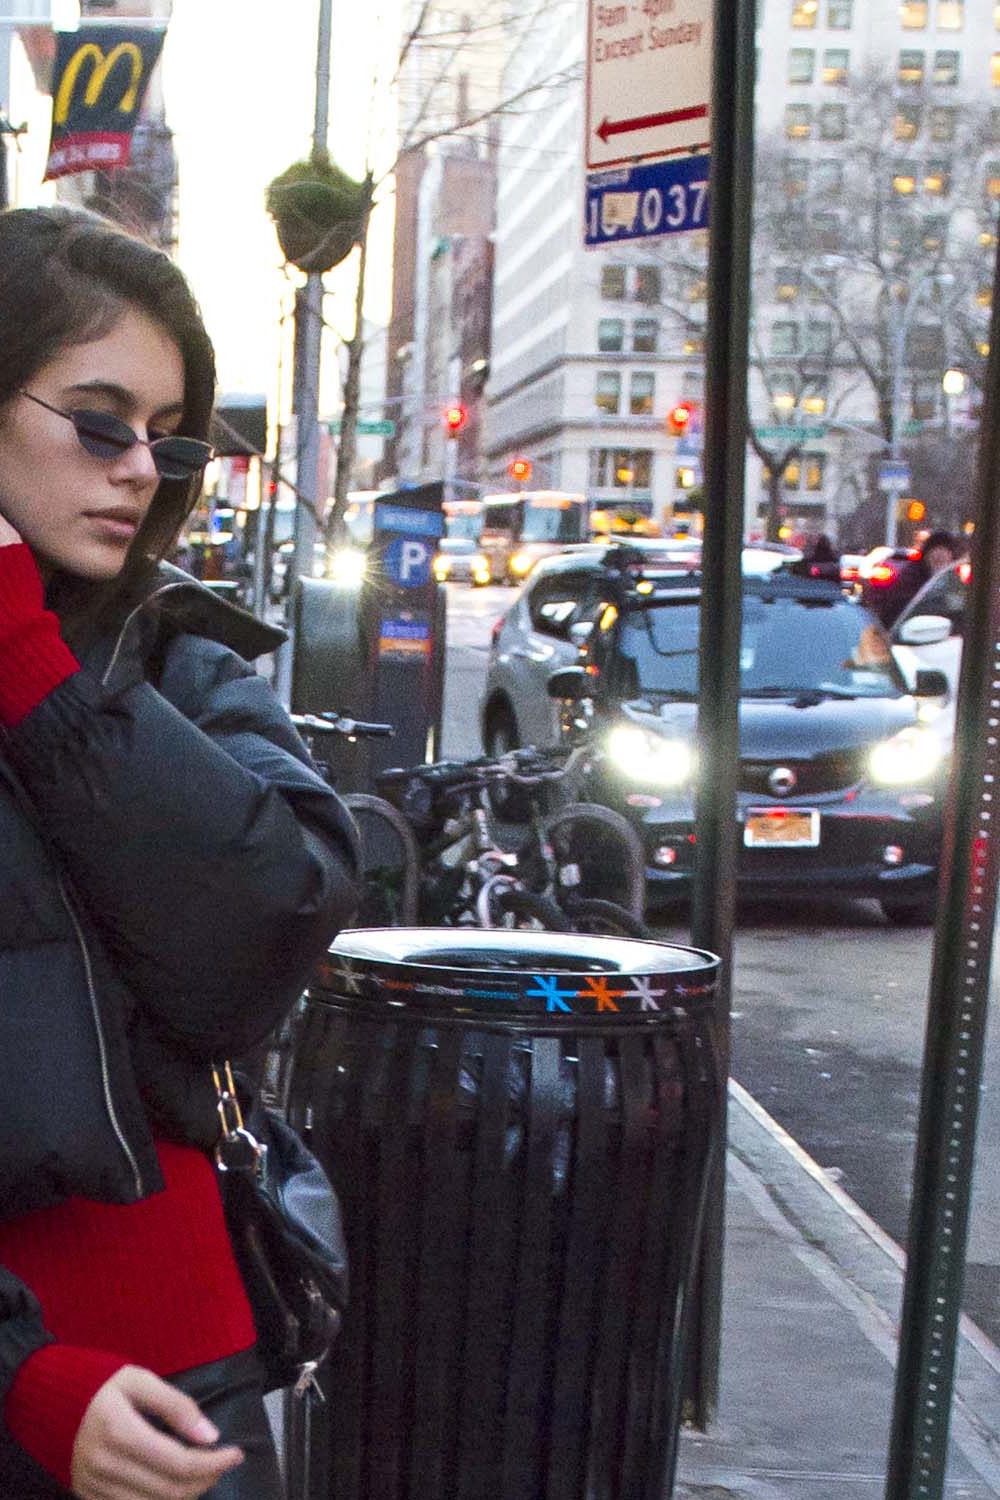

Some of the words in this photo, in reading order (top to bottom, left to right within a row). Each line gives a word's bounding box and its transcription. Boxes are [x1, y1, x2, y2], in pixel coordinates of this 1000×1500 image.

[594, 33, 643, 63] Except
[647, 22, 702, 51] Sunday
[400, 540, 427, 580] P
